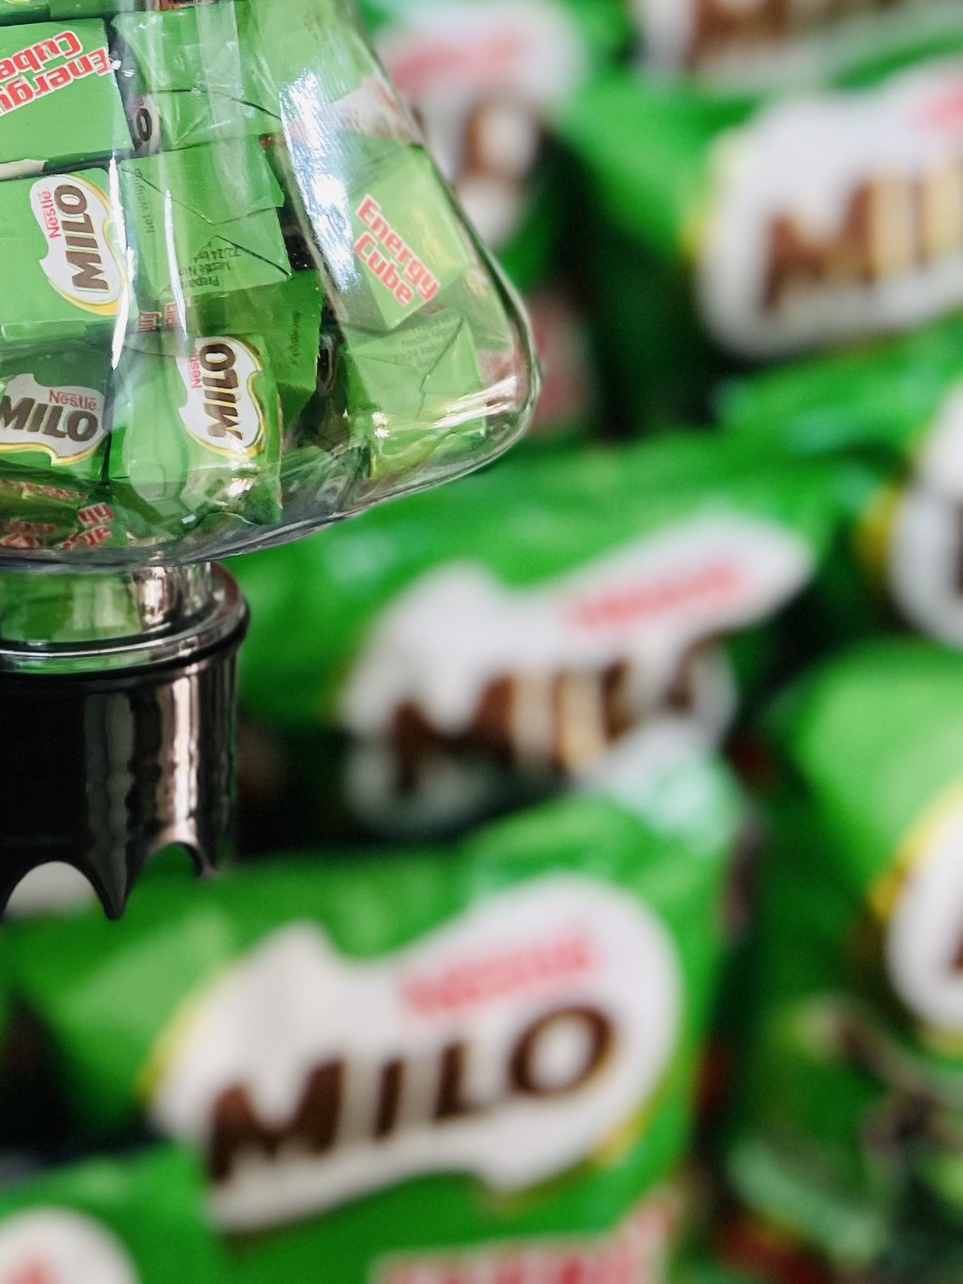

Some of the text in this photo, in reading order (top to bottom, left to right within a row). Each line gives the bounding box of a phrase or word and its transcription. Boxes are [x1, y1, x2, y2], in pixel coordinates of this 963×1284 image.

[53, 184, 110, 294] MILO
[353, 231, 415, 308] Cube
[354, 192, 441, 303] Energy
[198, 342, 245, 442] MILO
[207, 1004, 617, 1186] MILO
